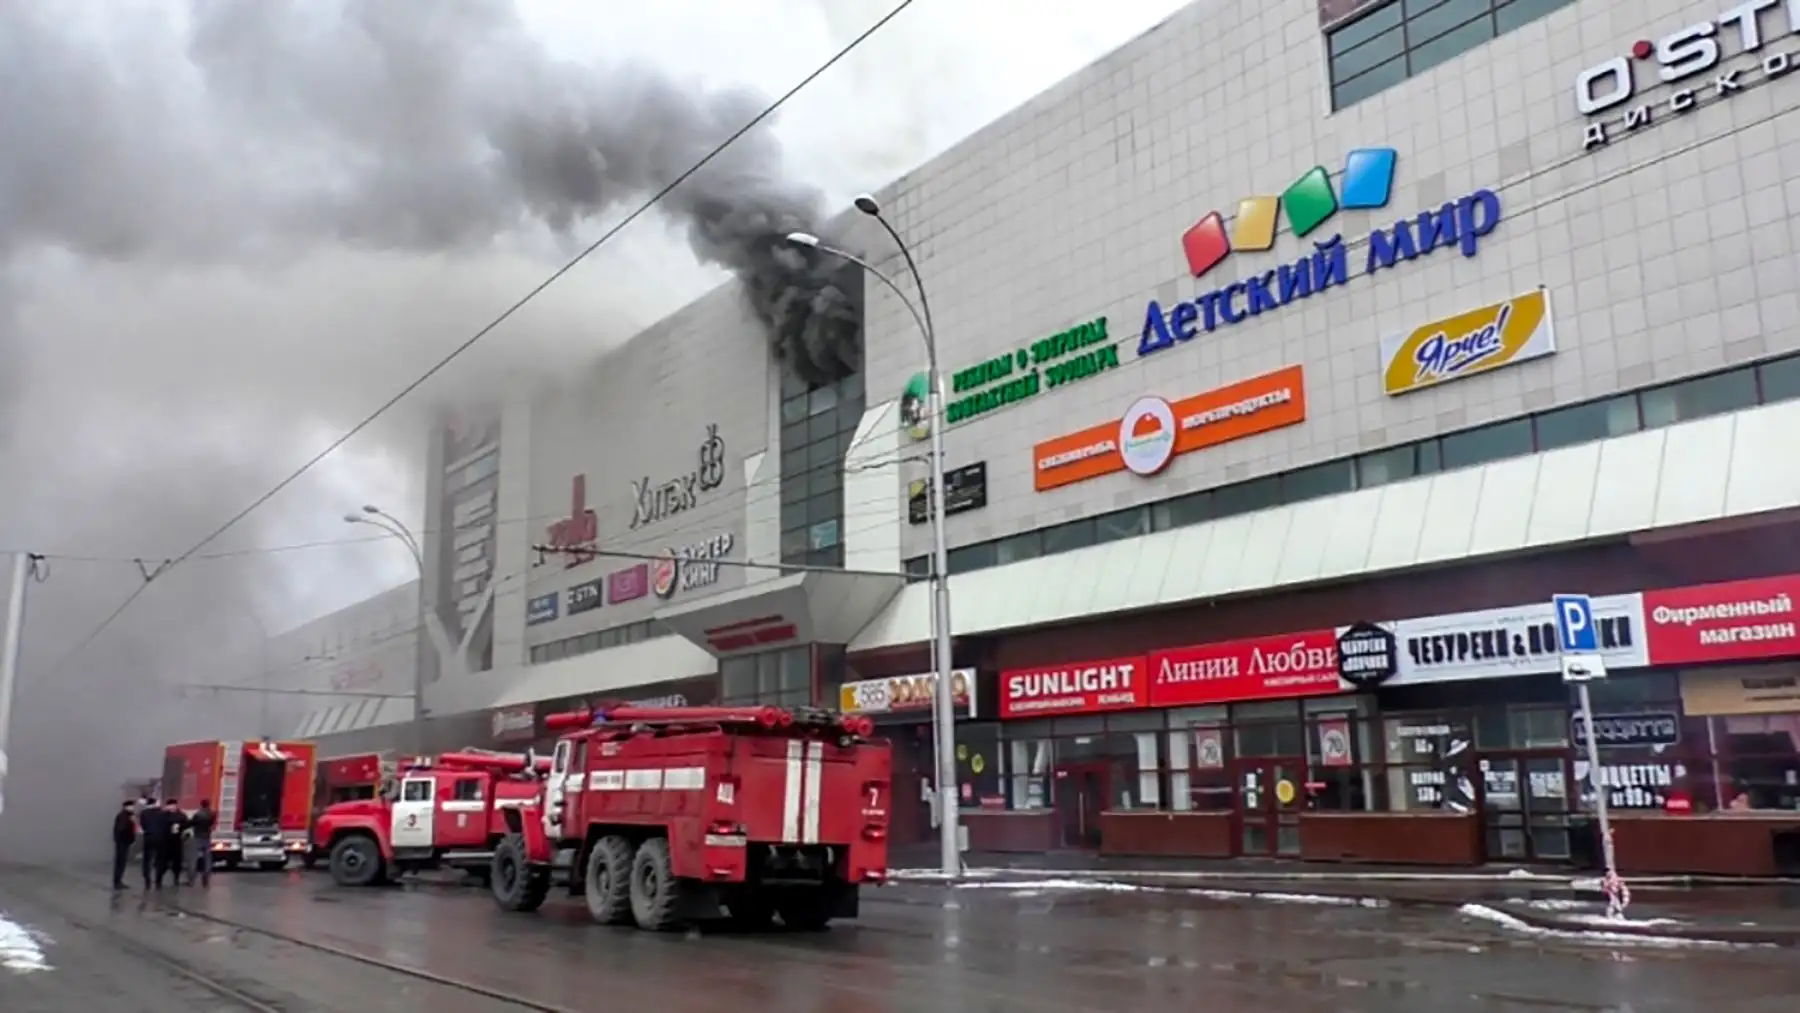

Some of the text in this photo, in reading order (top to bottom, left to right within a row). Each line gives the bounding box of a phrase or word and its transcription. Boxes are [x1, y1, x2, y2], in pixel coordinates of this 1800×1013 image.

[1137, 188, 1501, 356] Детский мир
[1415, 303, 1512, 375] Ярче!
[1563, 602, 1586, 646] P
[1652, 593, 1793, 626] Фирменный
[1407, 615, 1632, 666] ЧЕБУРЕКИ & ПОКИ
[1699, 622, 1796, 645] магазин
[1008, 664, 1135, 698] SUNLIGHT
[1156, 655, 1240, 685] Линии
[860, 688, 885, 705] 585
[868, 787, 879, 806] 7
